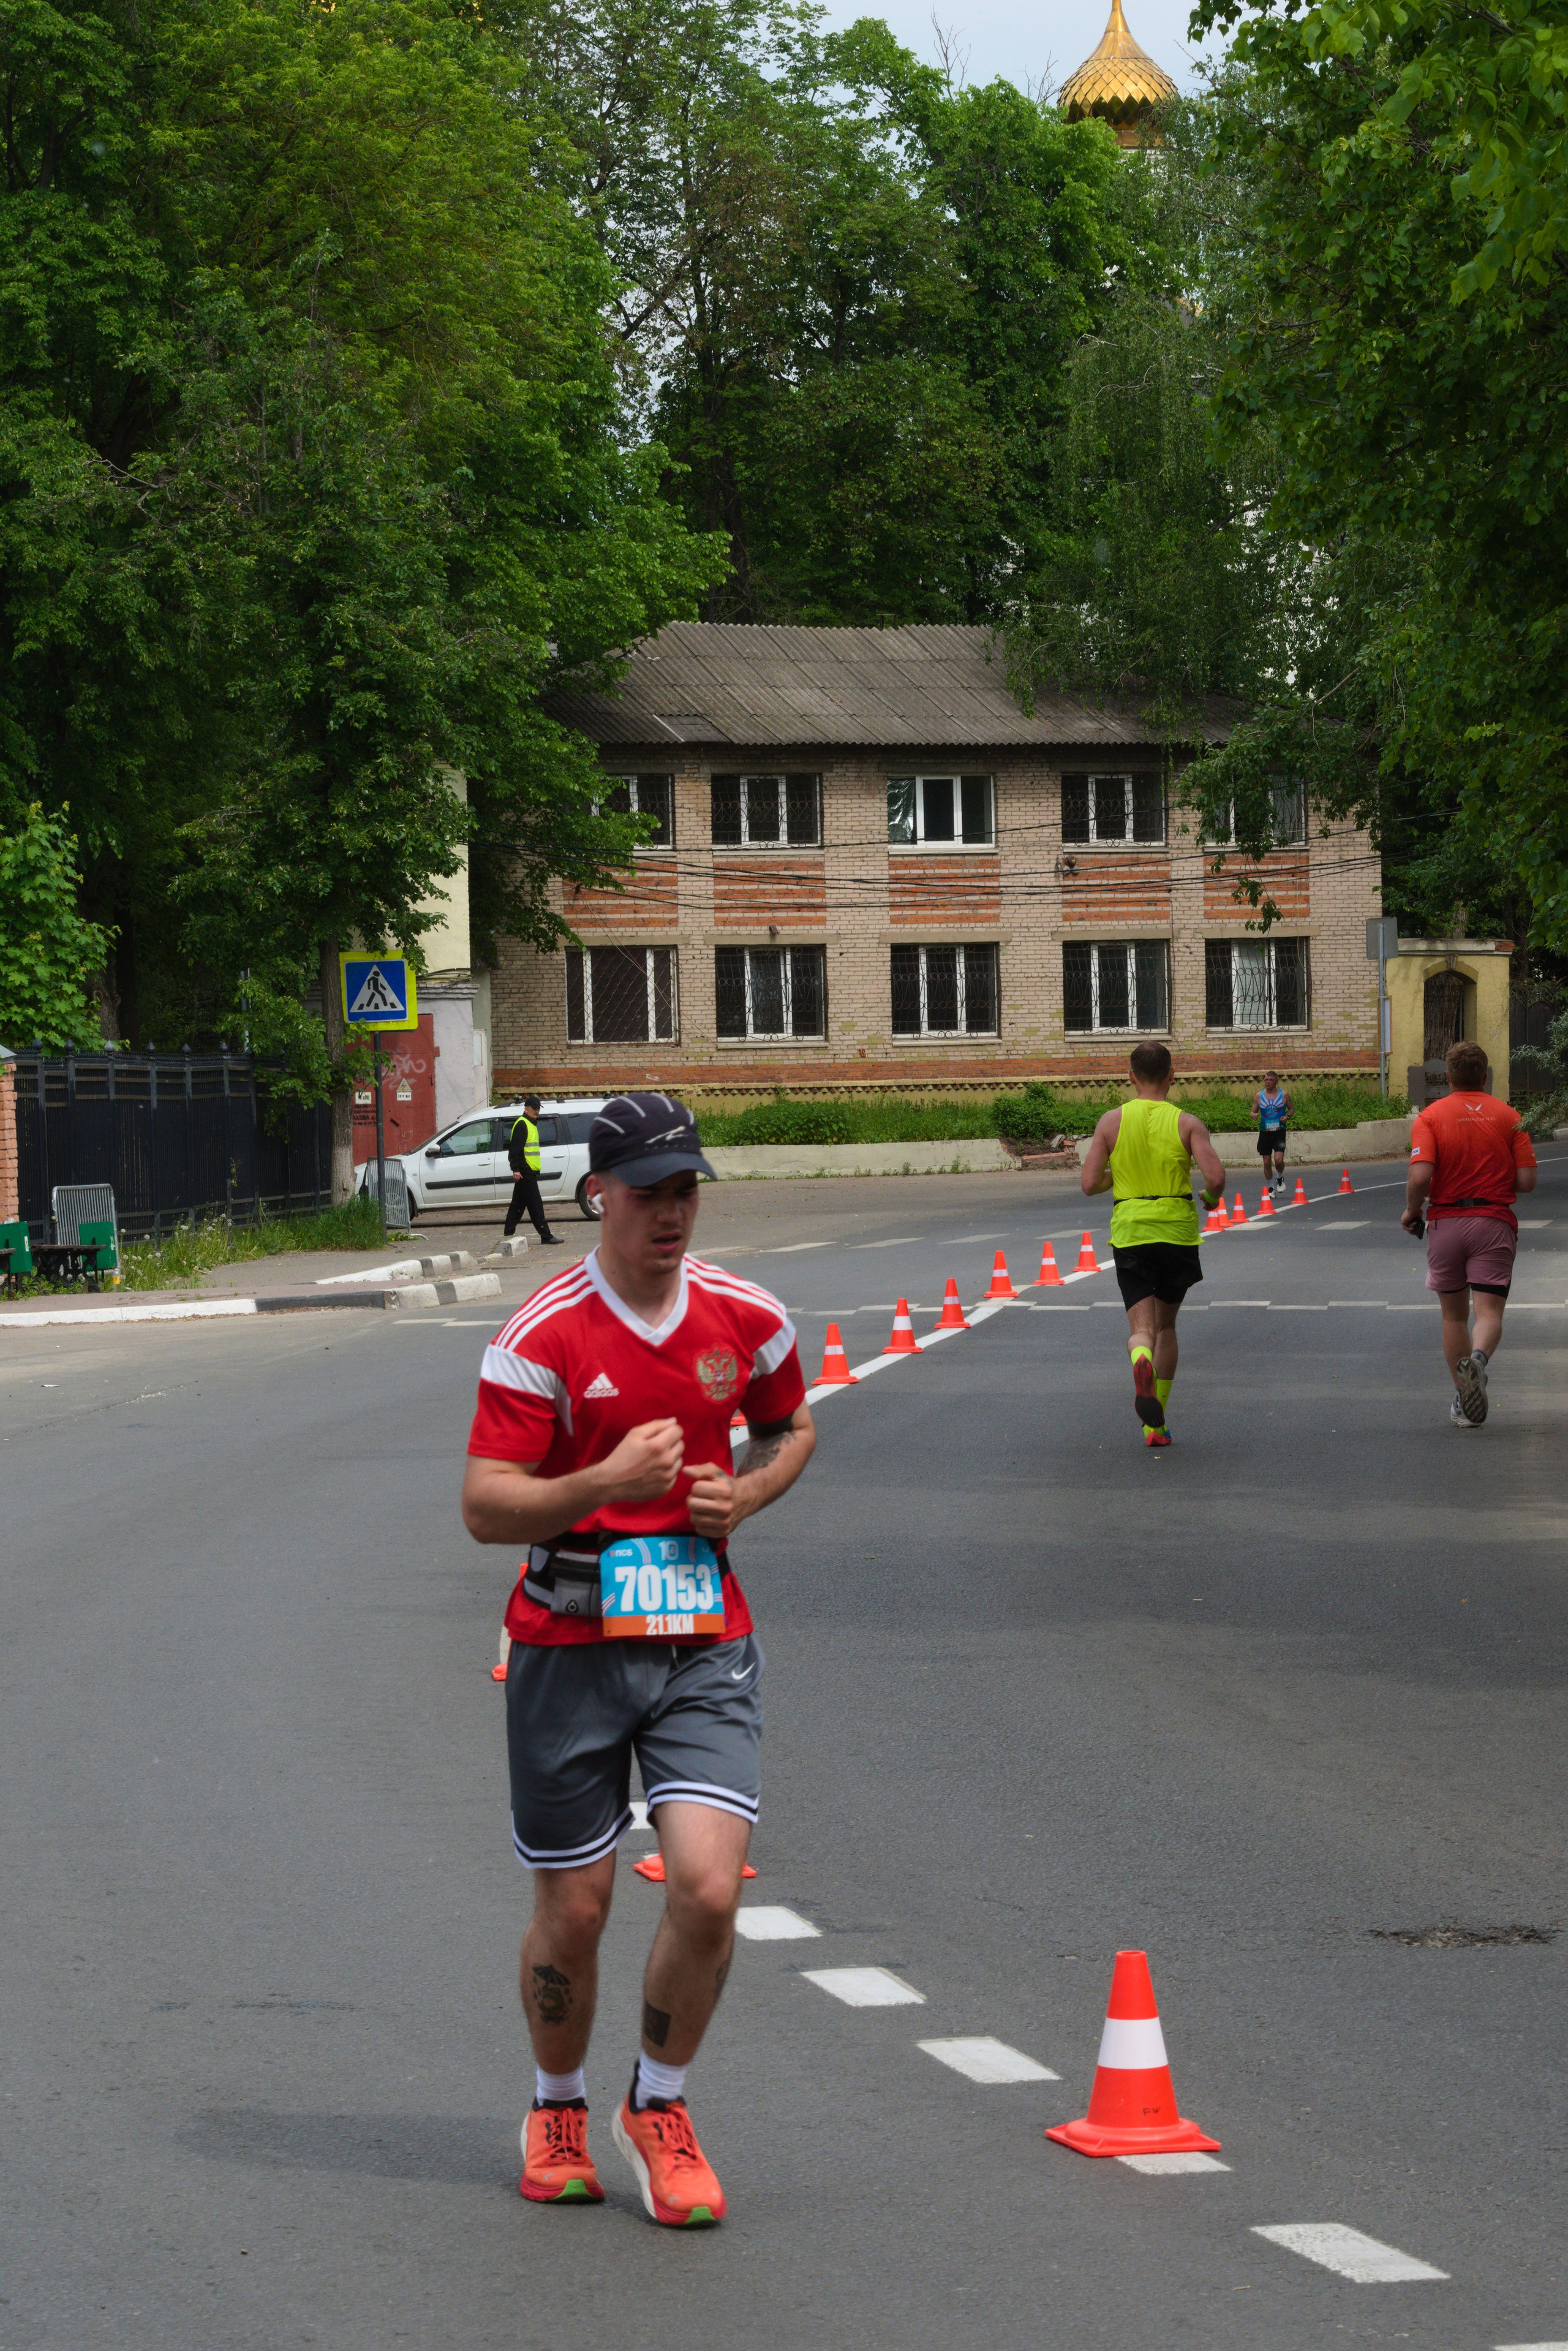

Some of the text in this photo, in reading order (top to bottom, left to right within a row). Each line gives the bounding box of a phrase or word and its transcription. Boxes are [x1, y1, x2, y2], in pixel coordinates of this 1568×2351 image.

[584, 1387, 619, 1398] adidas
[658, 1541, 678, 1560] 10
[614, 1563, 714, 1612] 70153
[646, 1614, 694, 1635] 21.1KM
